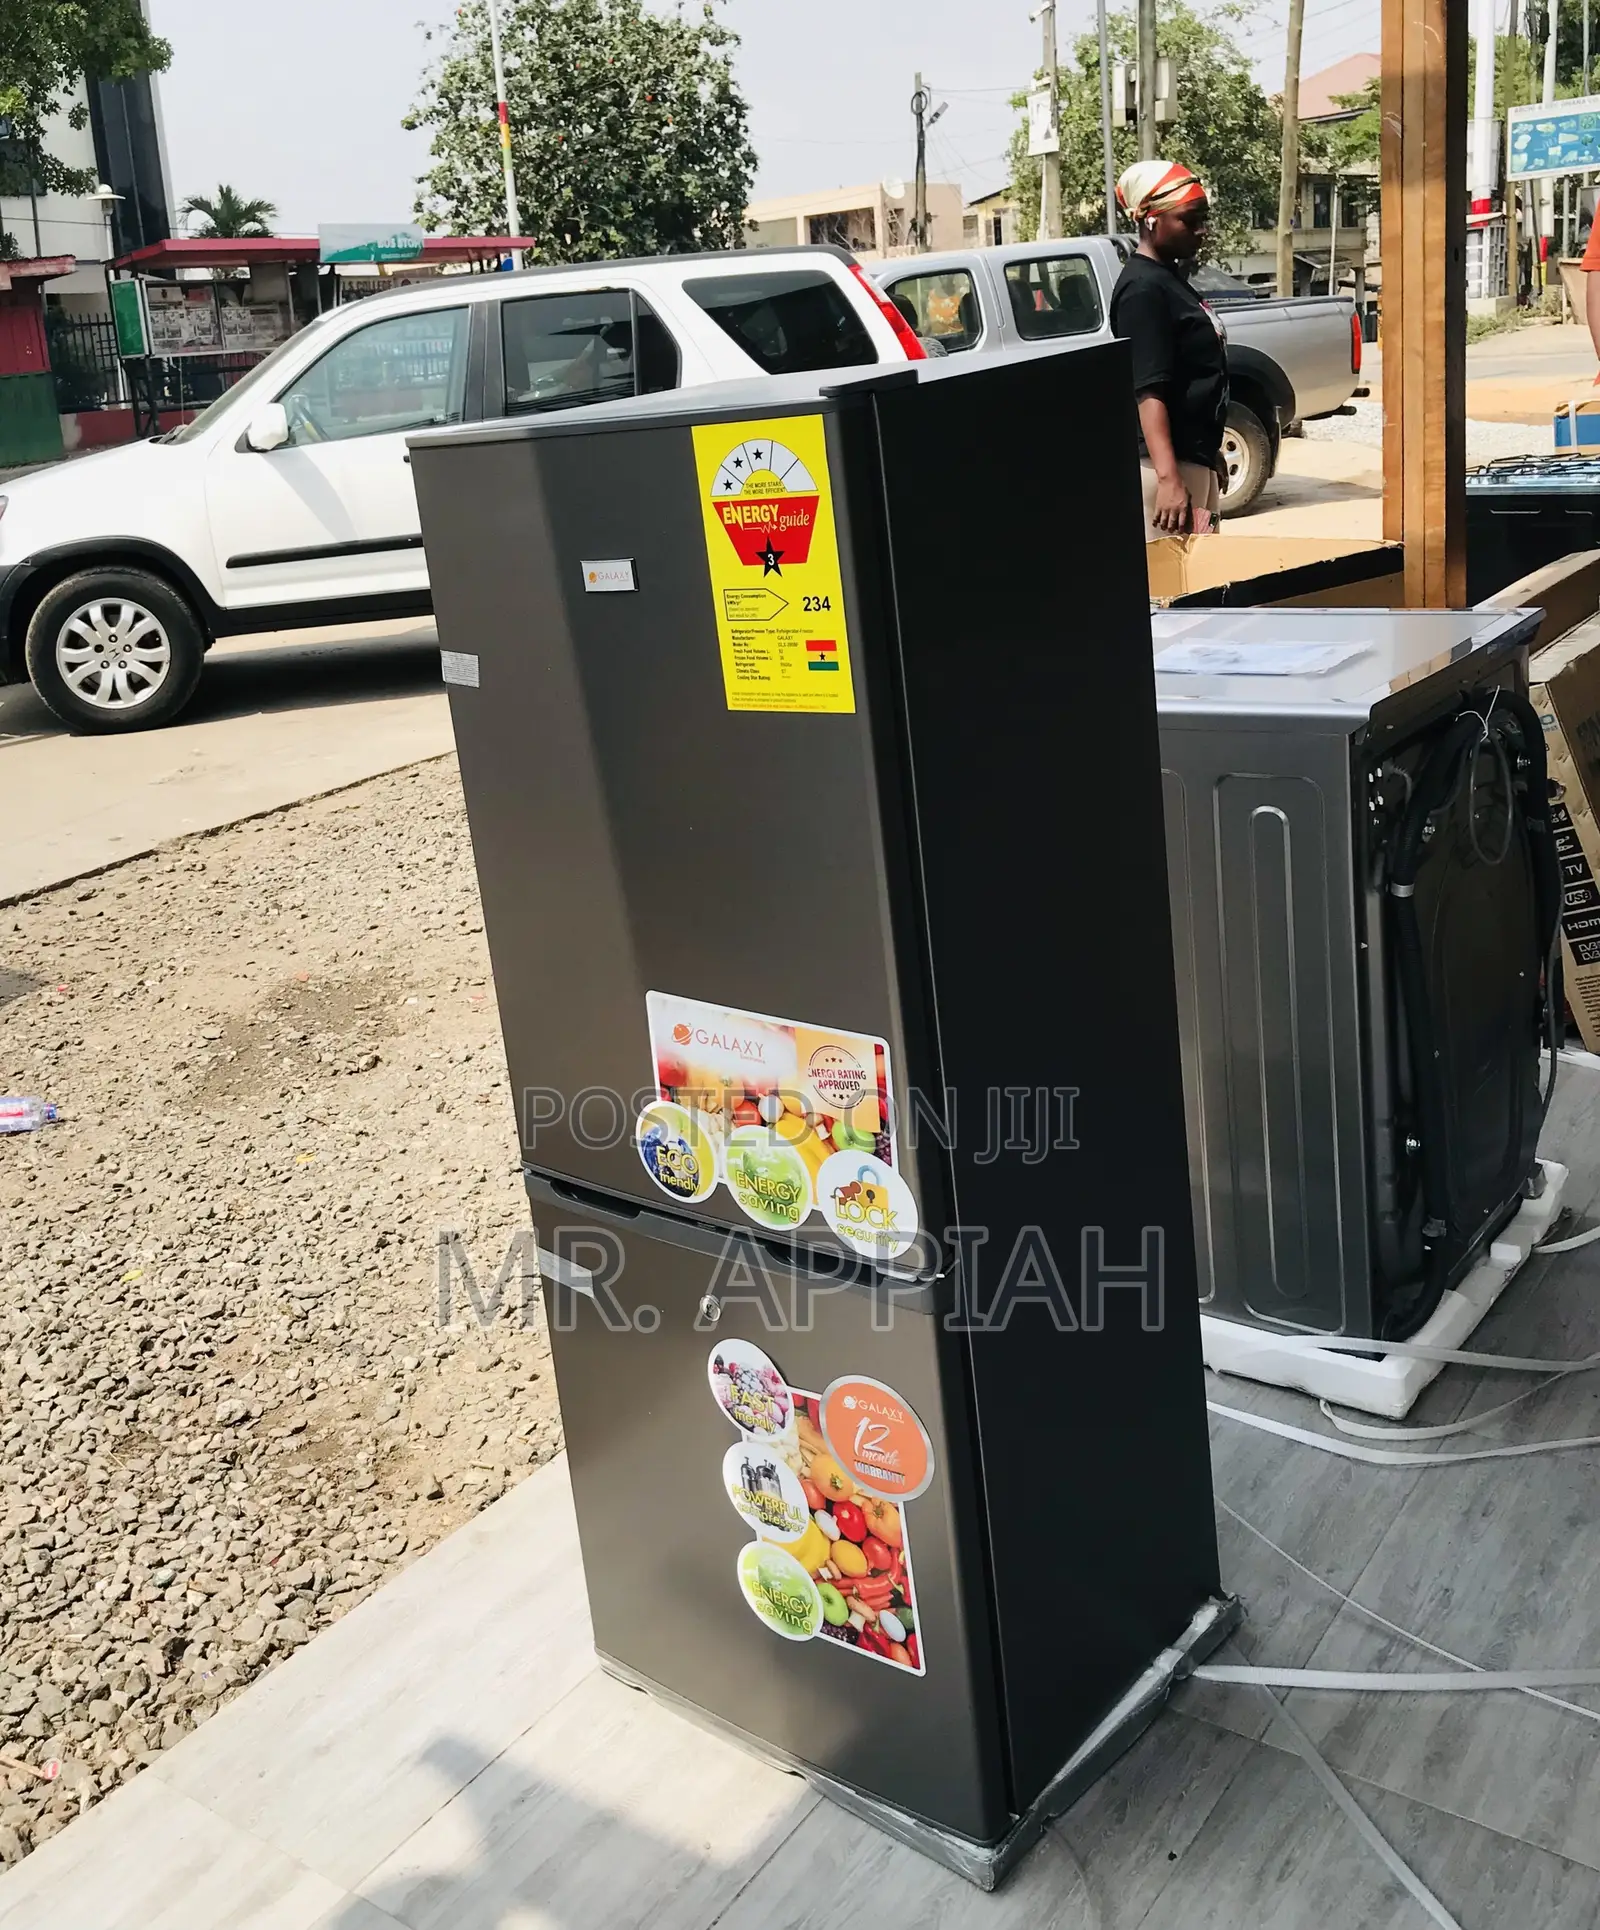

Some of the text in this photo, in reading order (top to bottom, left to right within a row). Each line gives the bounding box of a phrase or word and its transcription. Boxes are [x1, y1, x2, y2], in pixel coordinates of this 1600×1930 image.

[722, 501, 810, 532] ENERGY guide
[597, 569, 630, 581] GALAXY
[767, 553, 775, 566] 3
[802, 595, 832, 612] 234
[1565, 863, 1583, 876] TV
[1565, 890, 1592, 905] USB
[695, 1028, 764, 1058] GALAXY
[818, 1080, 860, 1091] APPROVED
[837, 1069, 867, 1080] RATING
[655, 1145, 699, 1176] ECO
[659, 1170, 701, 1197] friendly
[735, 1169, 802, 1201] ENERGY
[738, 1191, 800, 1224] saving
[834, 1195, 900, 1234] LOCK
[836, 1223, 899, 1254] security
[729, 1383, 775, 1416] FAST
[857, 1399, 904, 1420] GALAXY
[853, 1416, 890, 1457] 12
[853, 1460, 905, 1486] WARRANTY
[731, 1483, 807, 1524] POWERFUL
[737, 1502, 805, 1533] compressor
[751, 1581, 813, 1618] ENERGY
[755, 1600, 813, 1635] saving
